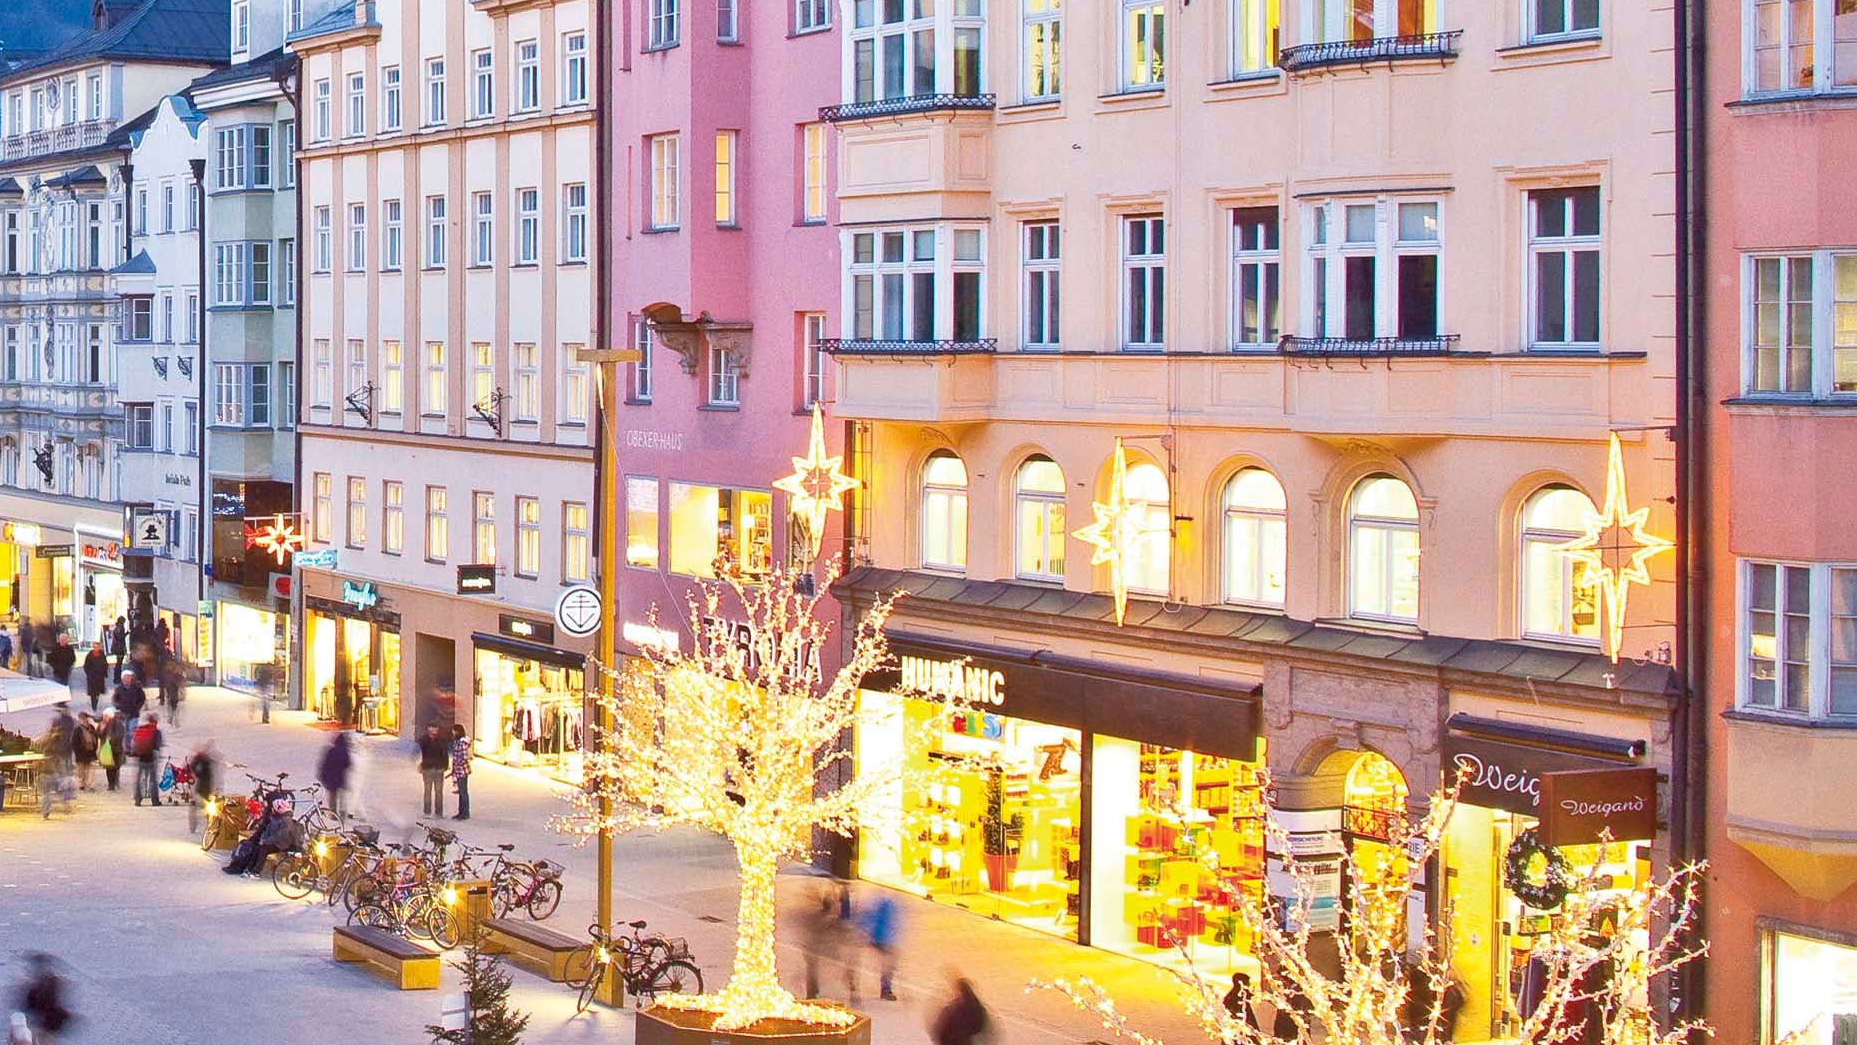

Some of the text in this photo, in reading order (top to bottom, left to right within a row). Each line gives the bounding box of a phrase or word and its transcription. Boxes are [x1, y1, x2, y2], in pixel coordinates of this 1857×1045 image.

[901, 655, 1005, 706] HUMANIC
[1453, 753, 1540, 806] Weig
[1560, 796, 1645, 817] Weigand
